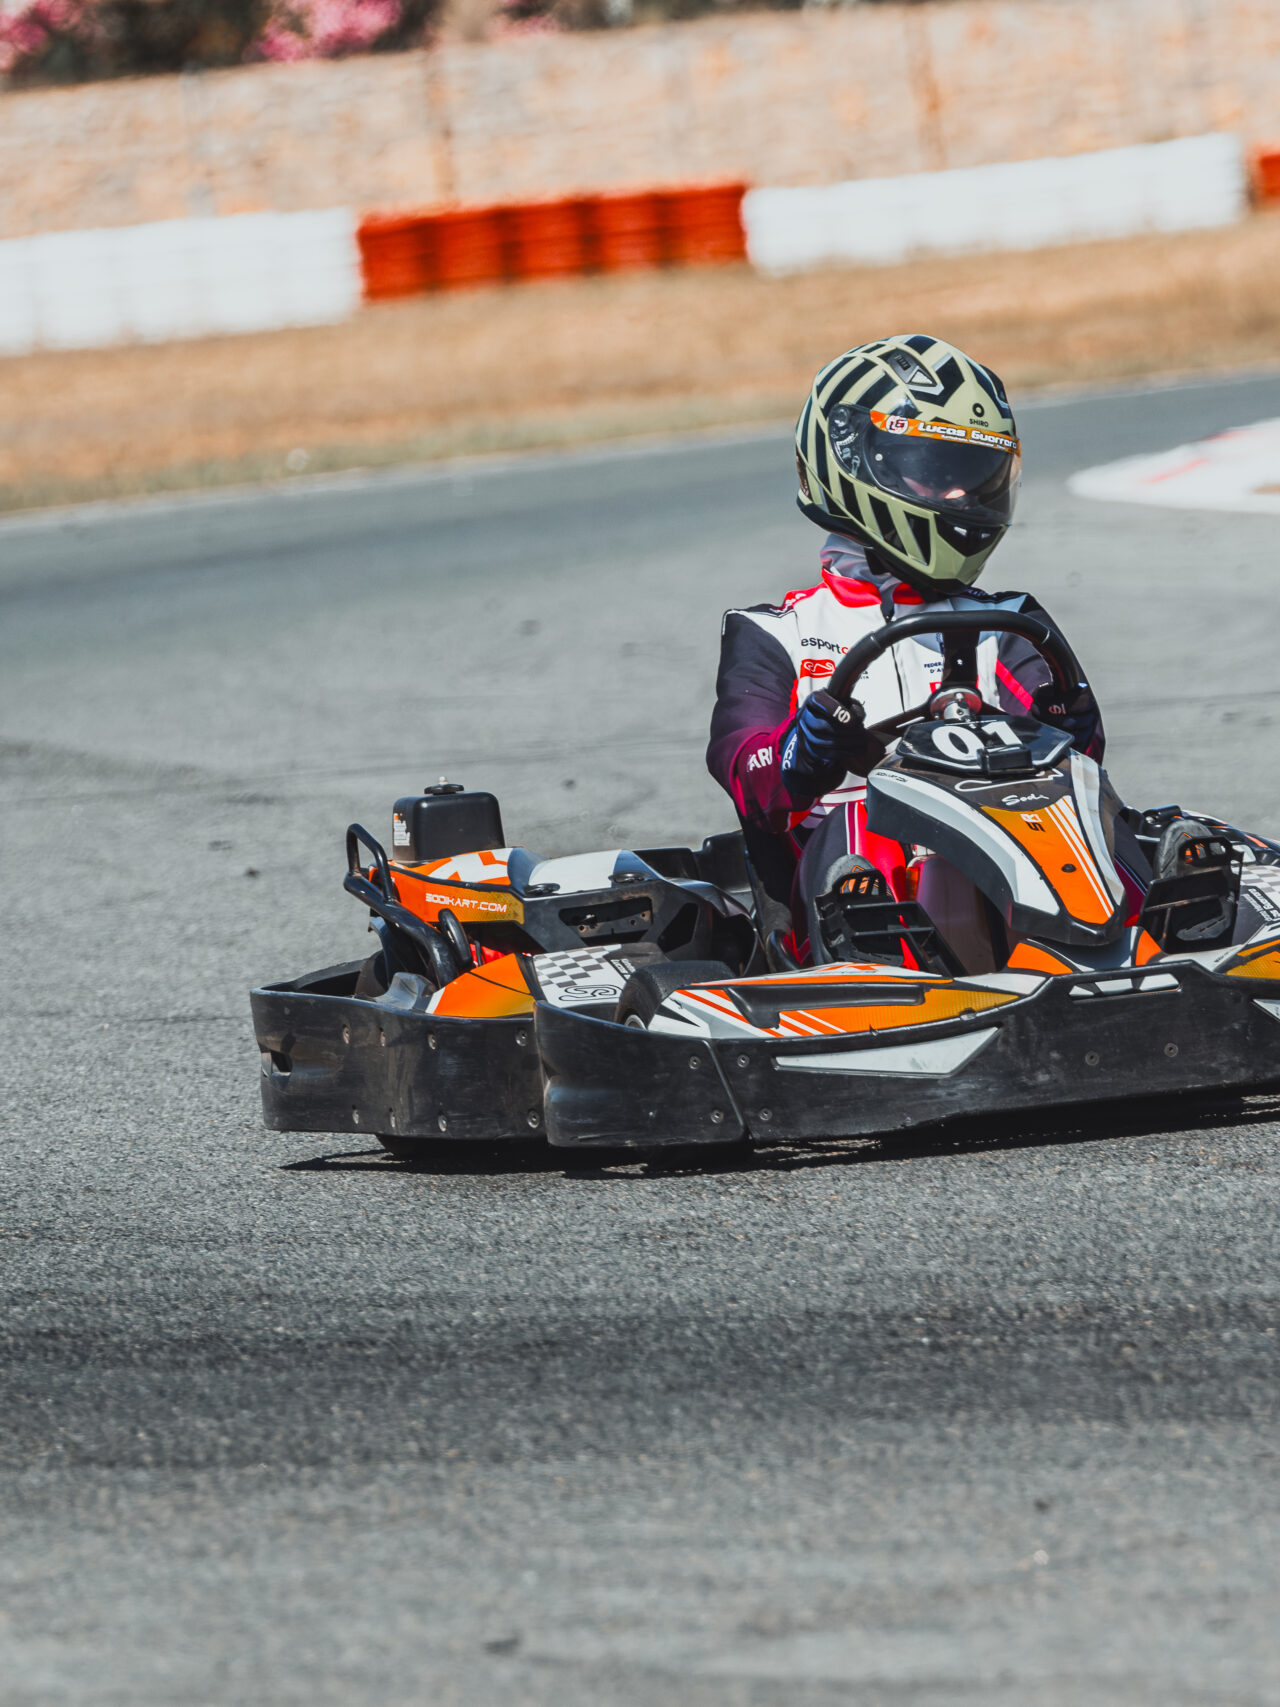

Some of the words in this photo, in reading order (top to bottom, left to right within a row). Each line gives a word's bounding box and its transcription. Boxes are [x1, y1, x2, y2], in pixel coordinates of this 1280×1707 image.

[969, 419, 989, 428] SHIRO
[931, 721, 1022, 761] 01
[425, 893, 507, 912] SODIKART.COM
